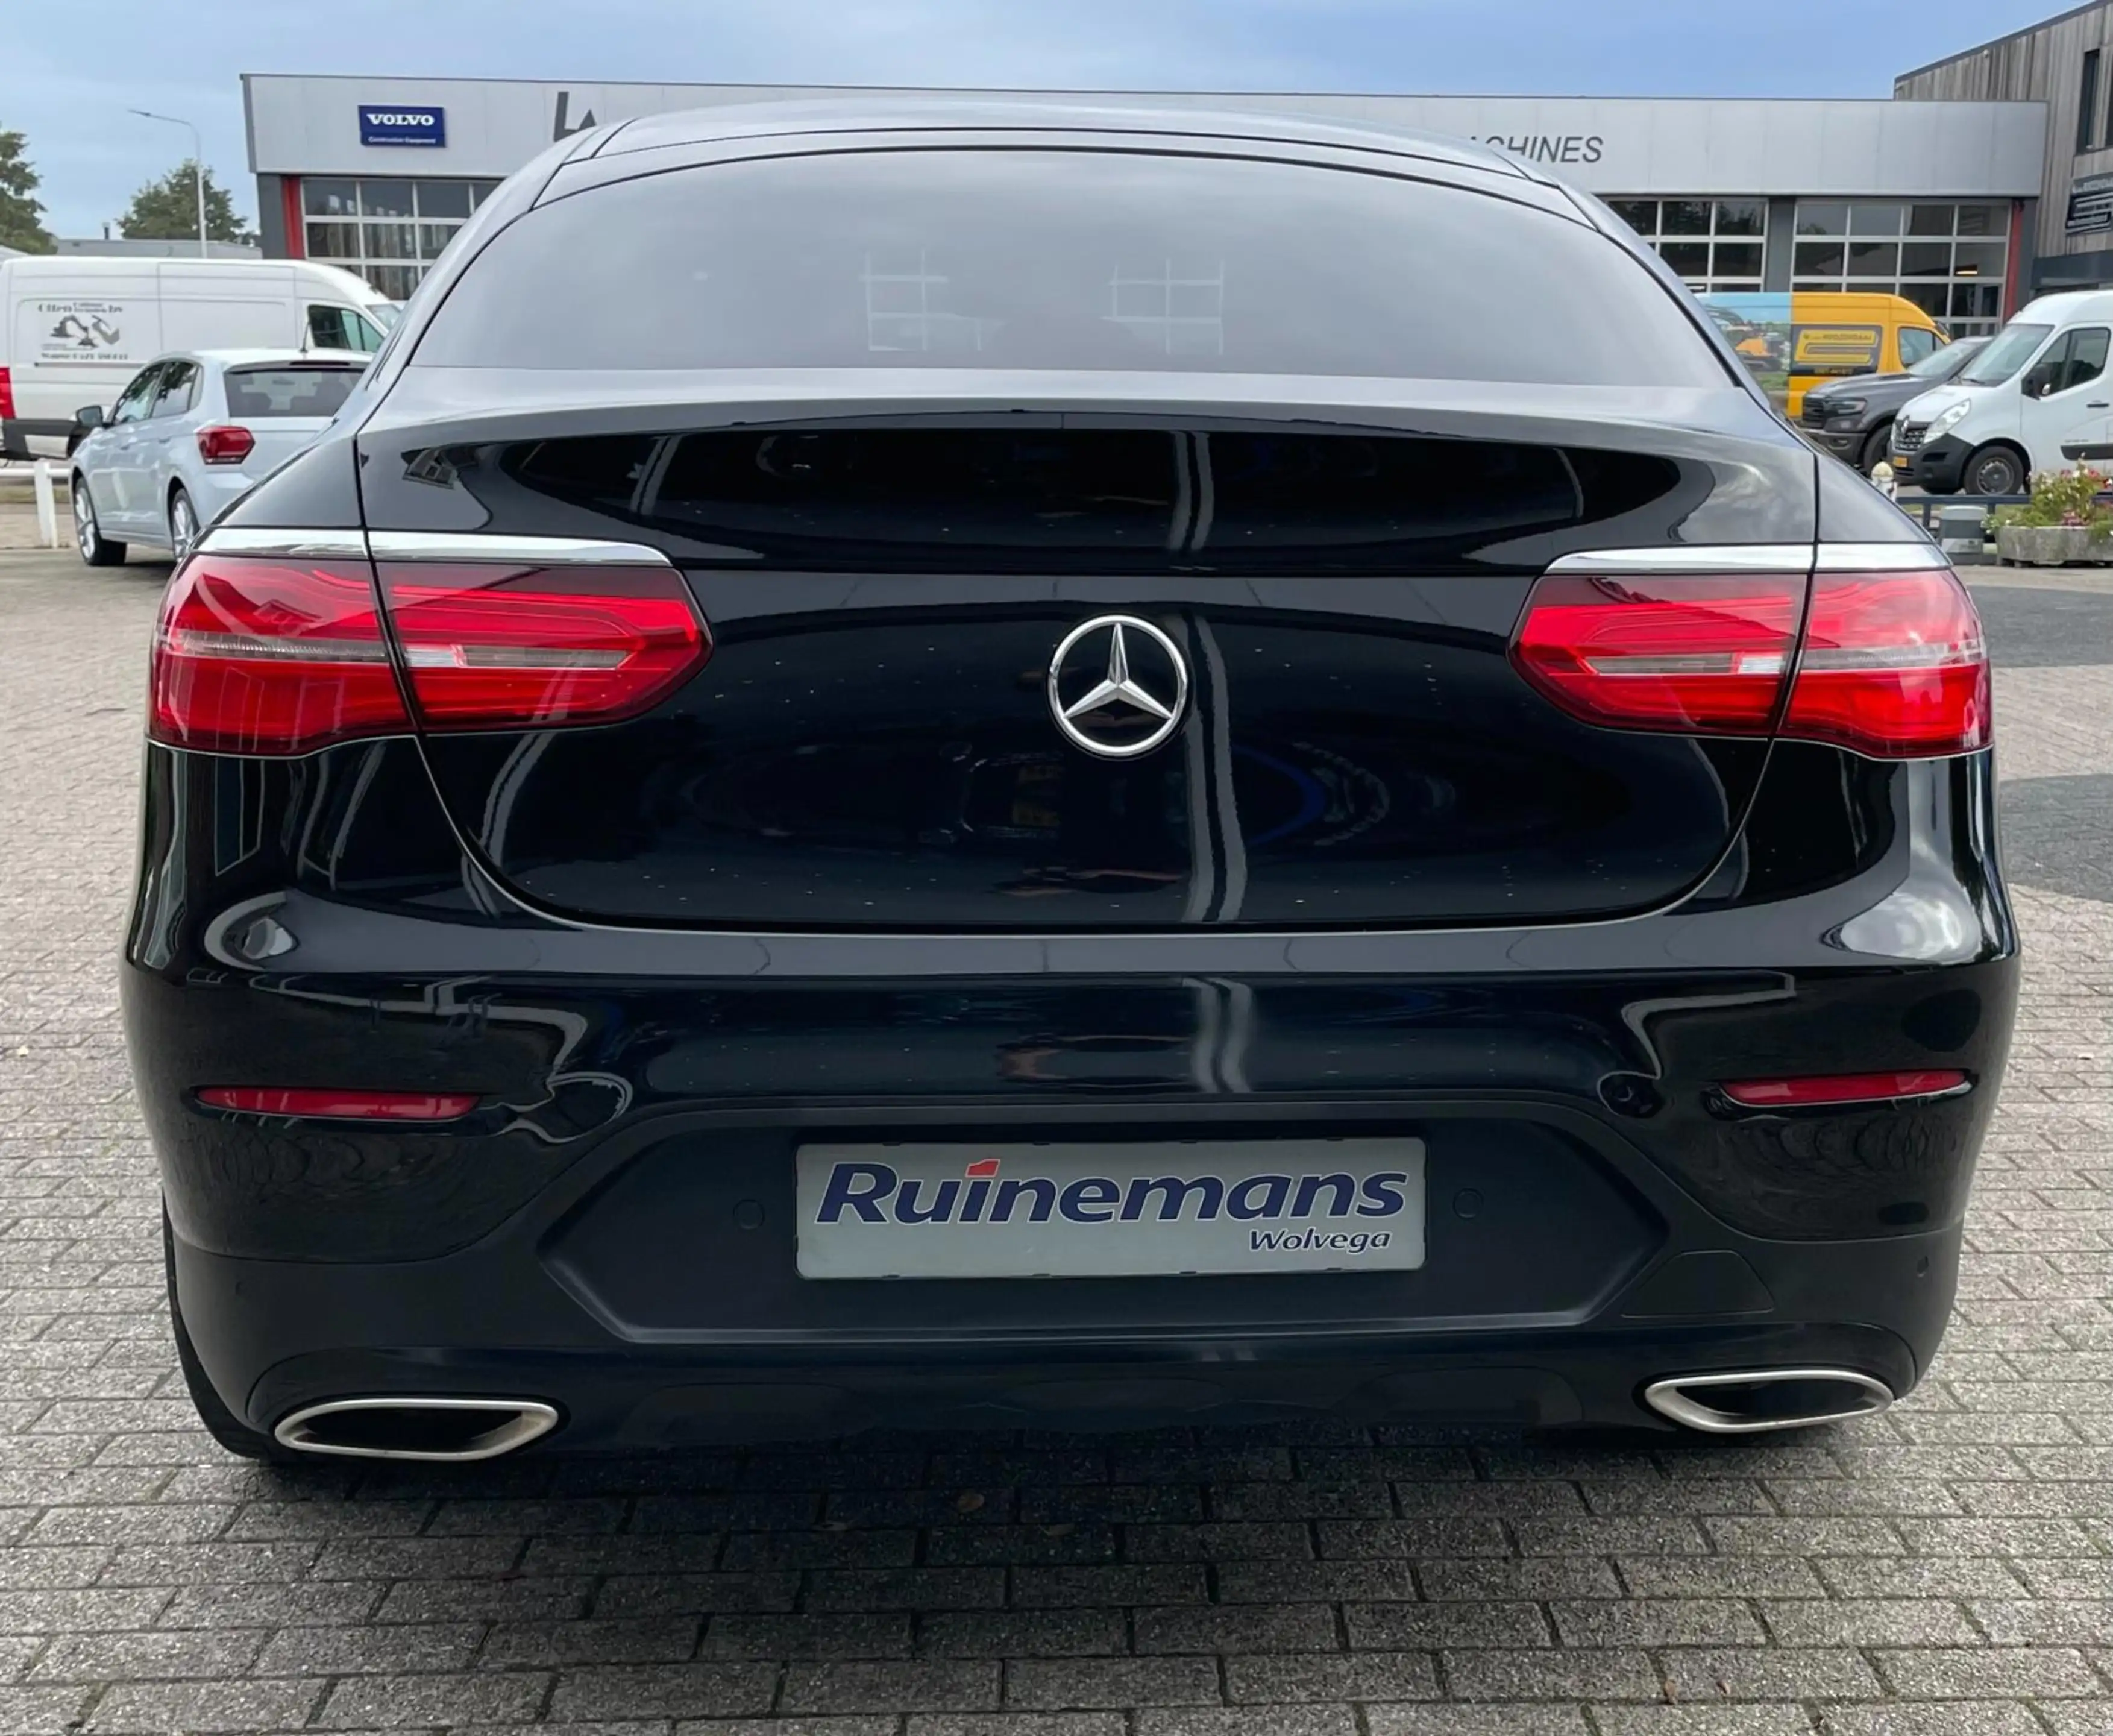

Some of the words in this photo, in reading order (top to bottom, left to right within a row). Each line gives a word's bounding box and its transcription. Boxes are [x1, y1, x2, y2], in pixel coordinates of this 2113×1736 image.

[366, 113, 435, 126] VOLVO
[814, 1159, 1408, 1225] Ruinemans
[1249, 1227, 1393, 1256] Wolvega
